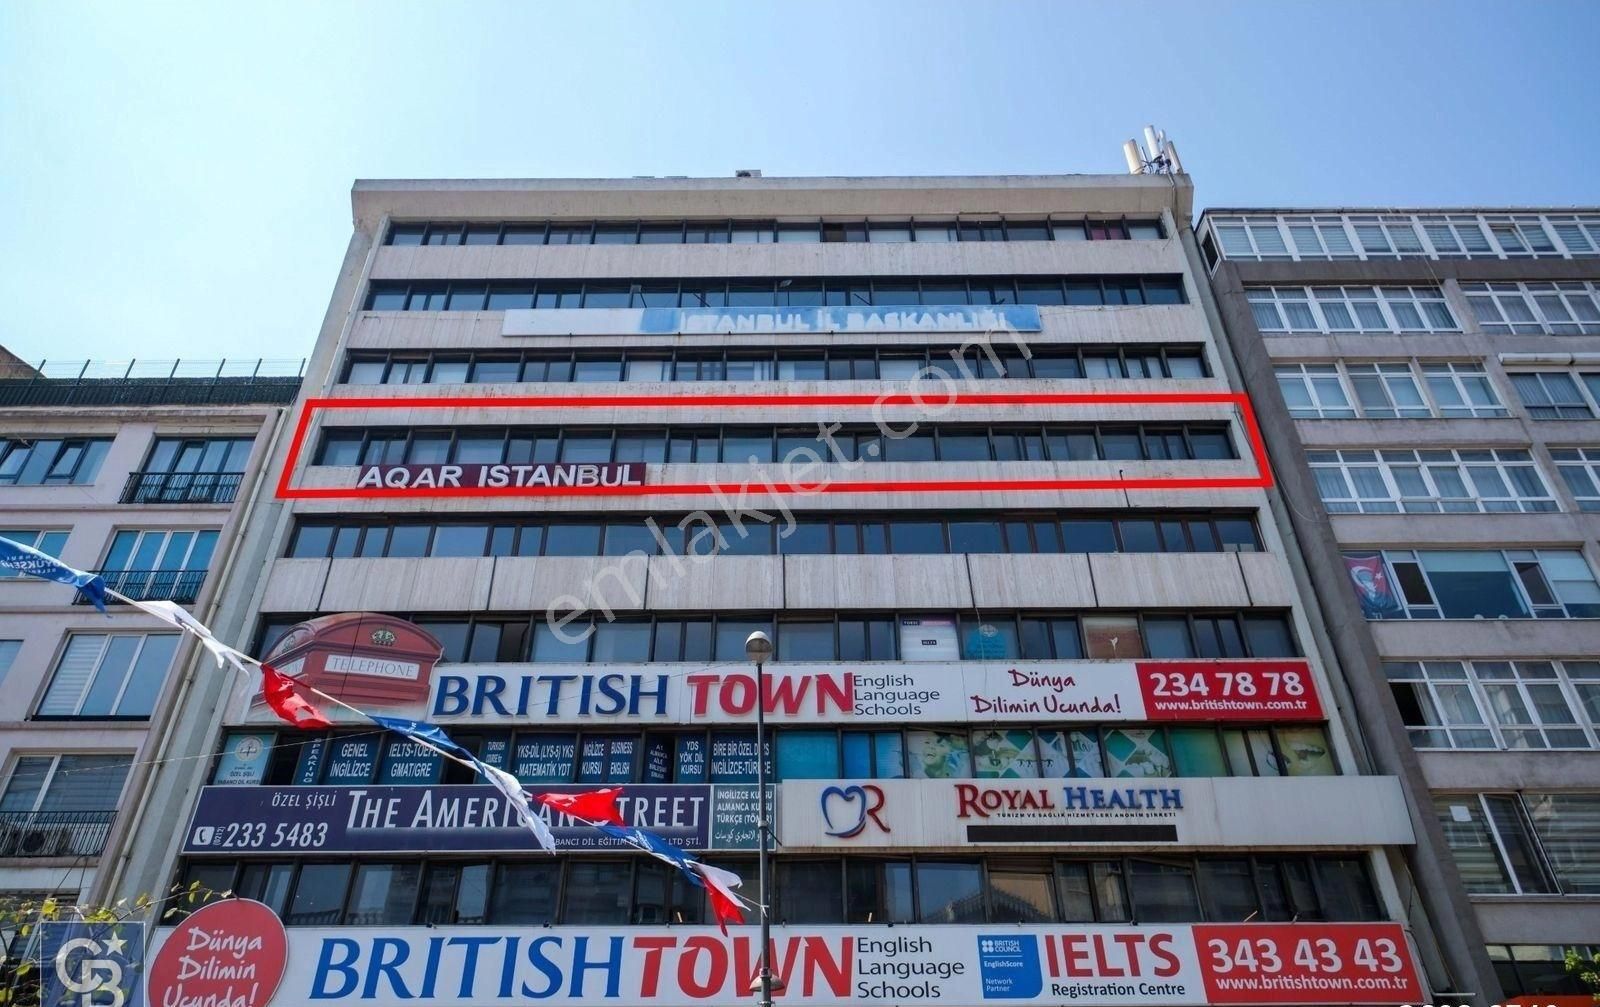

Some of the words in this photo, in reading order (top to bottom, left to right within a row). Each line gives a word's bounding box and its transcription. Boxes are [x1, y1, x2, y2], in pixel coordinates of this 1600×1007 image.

[356, 465, 462, 489] AQAR
[477, 464, 642, 488] ISTANBUL
[332, 656, 415, 677] TELEPHONE
[854, 675, 914, 689] English
[1008, 669, 1076, 692] Dünya
[1150, 672, 1209, 697] 234
[1215, 672, 1257, 697] 78
[1262, 671, 1304, 697] 78
[433, 673, 669, 717] BRITISH
[686, 672, 853, 717] TOWN
[854, 688, 941, 703] Language
[855, 703, 922, 716] Schools
[970, 694, 1040, 714] Dilimin
[1043, 693, 1121, 714] Ucunda!
[1155, 699, 1308, 711] www.britishtown.com.tr
[341, 743, 369, 757] GENEL
[517, 743, 539, 758] YKS-DİL
[562, 745, 574, 758] YKS
[687, 741, 699, 751] YDS
[713, 741, 726, 756] BİRE
[728, 741, 737, 755] BİR
[739, 741, 753, 755] ÖZEL
[680, 752, 692, 763] YÖK
[694, 751, 704, 763] DİL
[330, 760, 371, 777] İNGİLİZCE
[519, 761, 556, 776] MATEMATİK
[558, 763, 571, 776] YDT
[582, 762, 602, 775] KURSU
[681, 764, 702, 775] KURSU
[272, 792, 300, 807] ÖZEL
[306, 790, 337, 809] ŞİŞLİ
[717, 790, 749, 800] İNGİLİZCE
[954, 783, 1055, 818] ROYAL
[1063, 786, 1184, 810] HEALTH
[347, 790, 402, 829] THE
[594, 797, 704, 828] TREET
[717, 802, 749, 811] ALMANCA
[717, 813, 743, 825] TÜRKÇE
[213, 826, 225, 846] (0212)
[222, 823, 267, 848] 233
[271, 822, 328, 848] 5483
[555, 838, 579, 846] BANCI
[582, 837, 595, 846] DİL
[668, 838, 683, 846] LTD
[186, 926, 262, 959] Dünya
[857, 936, 933, 957] English
[984, 960, 1024, 968] EnglishScore
[1045, 933, 1181, 978] IELTS
[1208, 938, 1283, 973] 343
[1294, 938, 1343, 973] 43
[1354, 938, 1403, 973] 43
[177, 954, 256, 980] Dilimin
[308, 936, 625, 999] BRITISH
[633, 936, 854, 998] TOWN
[858, 959, 965, 979] Language
[857, 981, 941, 998] Schools
[1052, 982, 1135, 998] Registration
[1139, 982, 1186, 996] Centre
[1216, 974, 1408, 990] www.britishtown.com.tr
[163, 982, 259, 1007] Ucunda!
